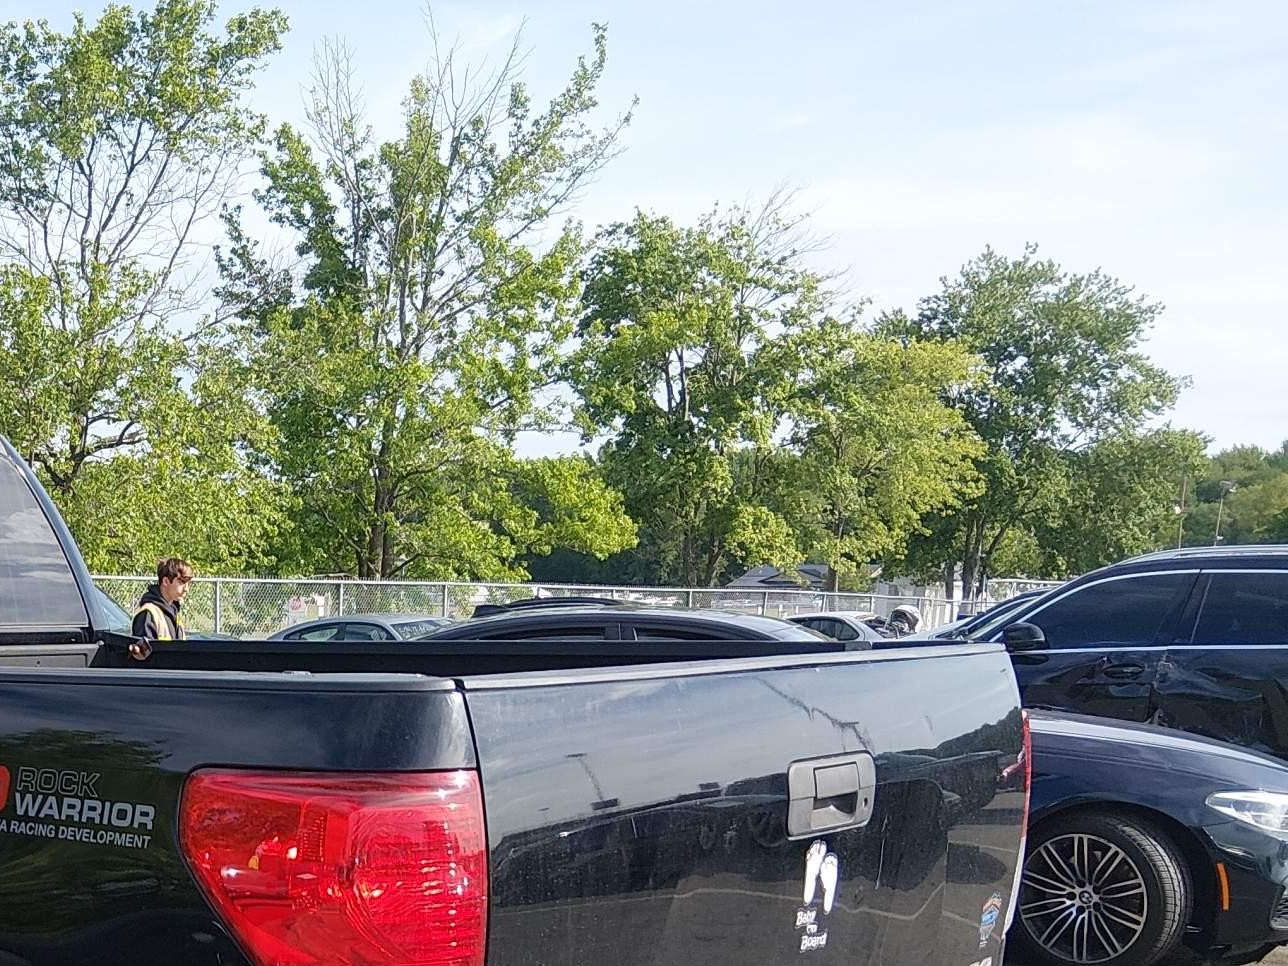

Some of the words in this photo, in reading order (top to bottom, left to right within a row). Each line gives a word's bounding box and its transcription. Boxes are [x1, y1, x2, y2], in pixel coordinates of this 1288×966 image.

[16, 766, 101, 797] ROCK
[14, 792, 156, 830] WARRIOR
[9, 820, 56, 838] RACING
[58, 826, 152, 849] DEVELOPMENT
[800, 932, 828, 951] Board
